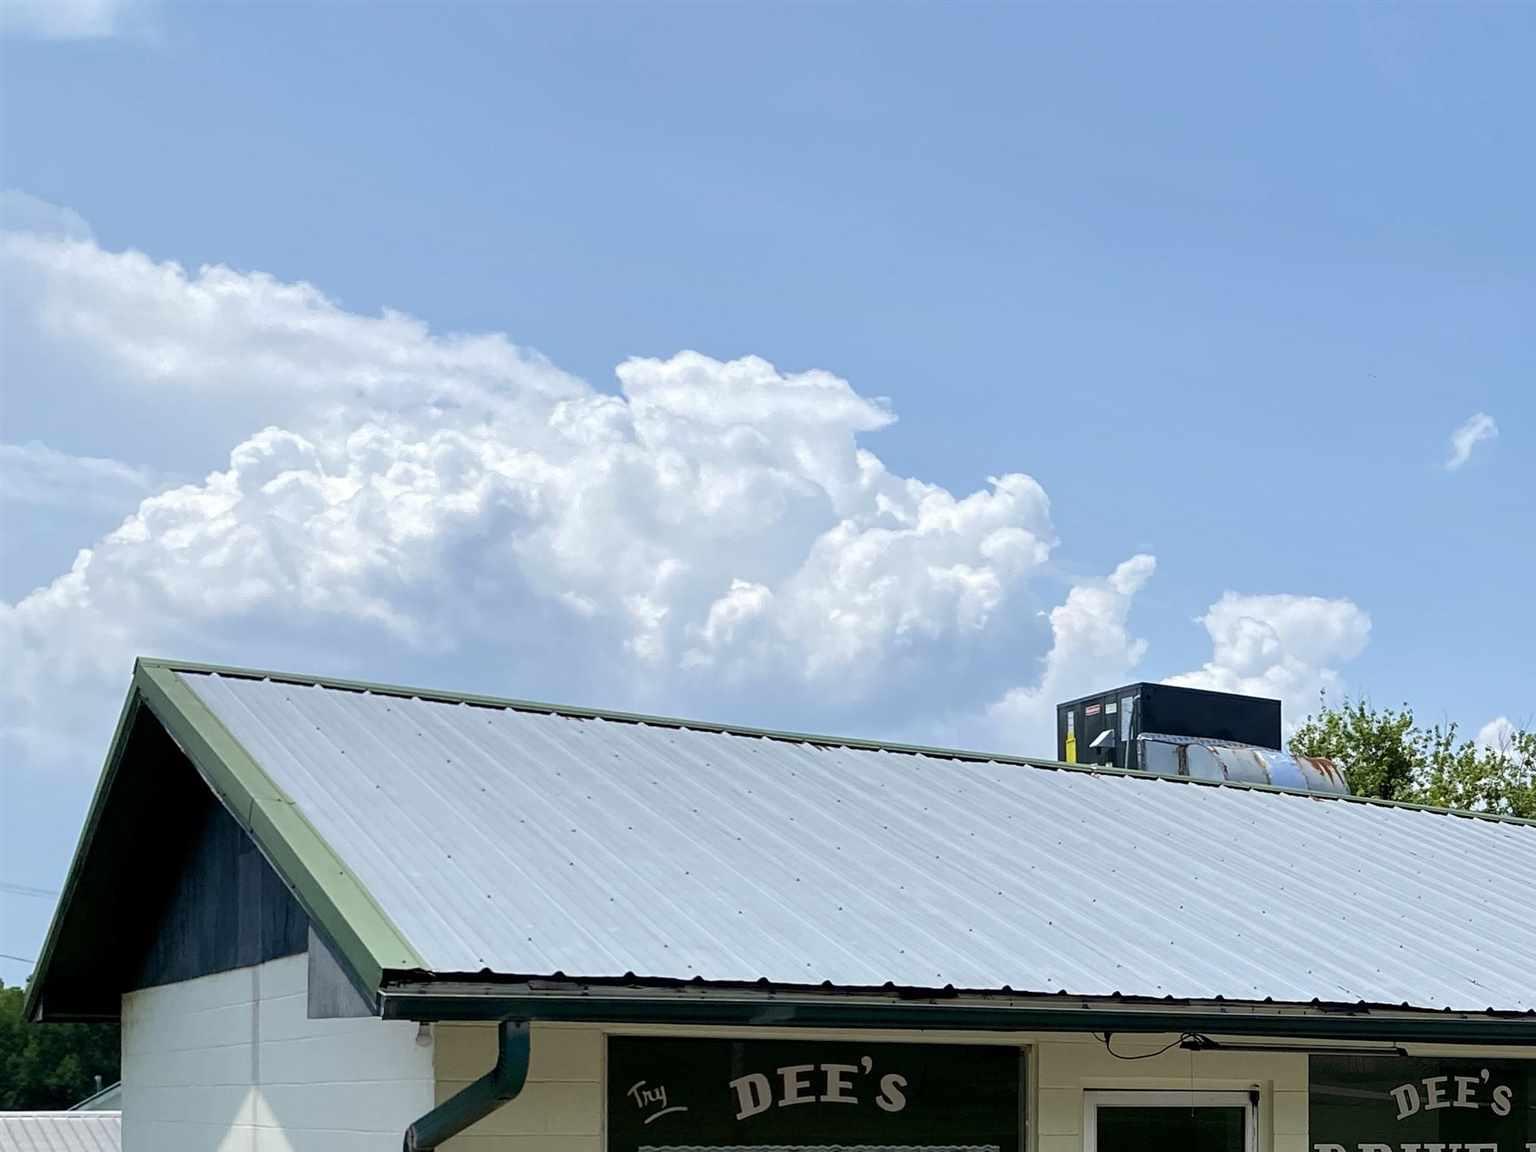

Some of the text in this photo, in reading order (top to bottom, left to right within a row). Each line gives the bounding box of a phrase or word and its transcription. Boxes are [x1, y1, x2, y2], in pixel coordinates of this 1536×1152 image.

[627, 1080, 667, 1109] Try
[730, 1055, 908, 1120] DEE'S
[1390, 1068, 1513, 1120] DEE'S
